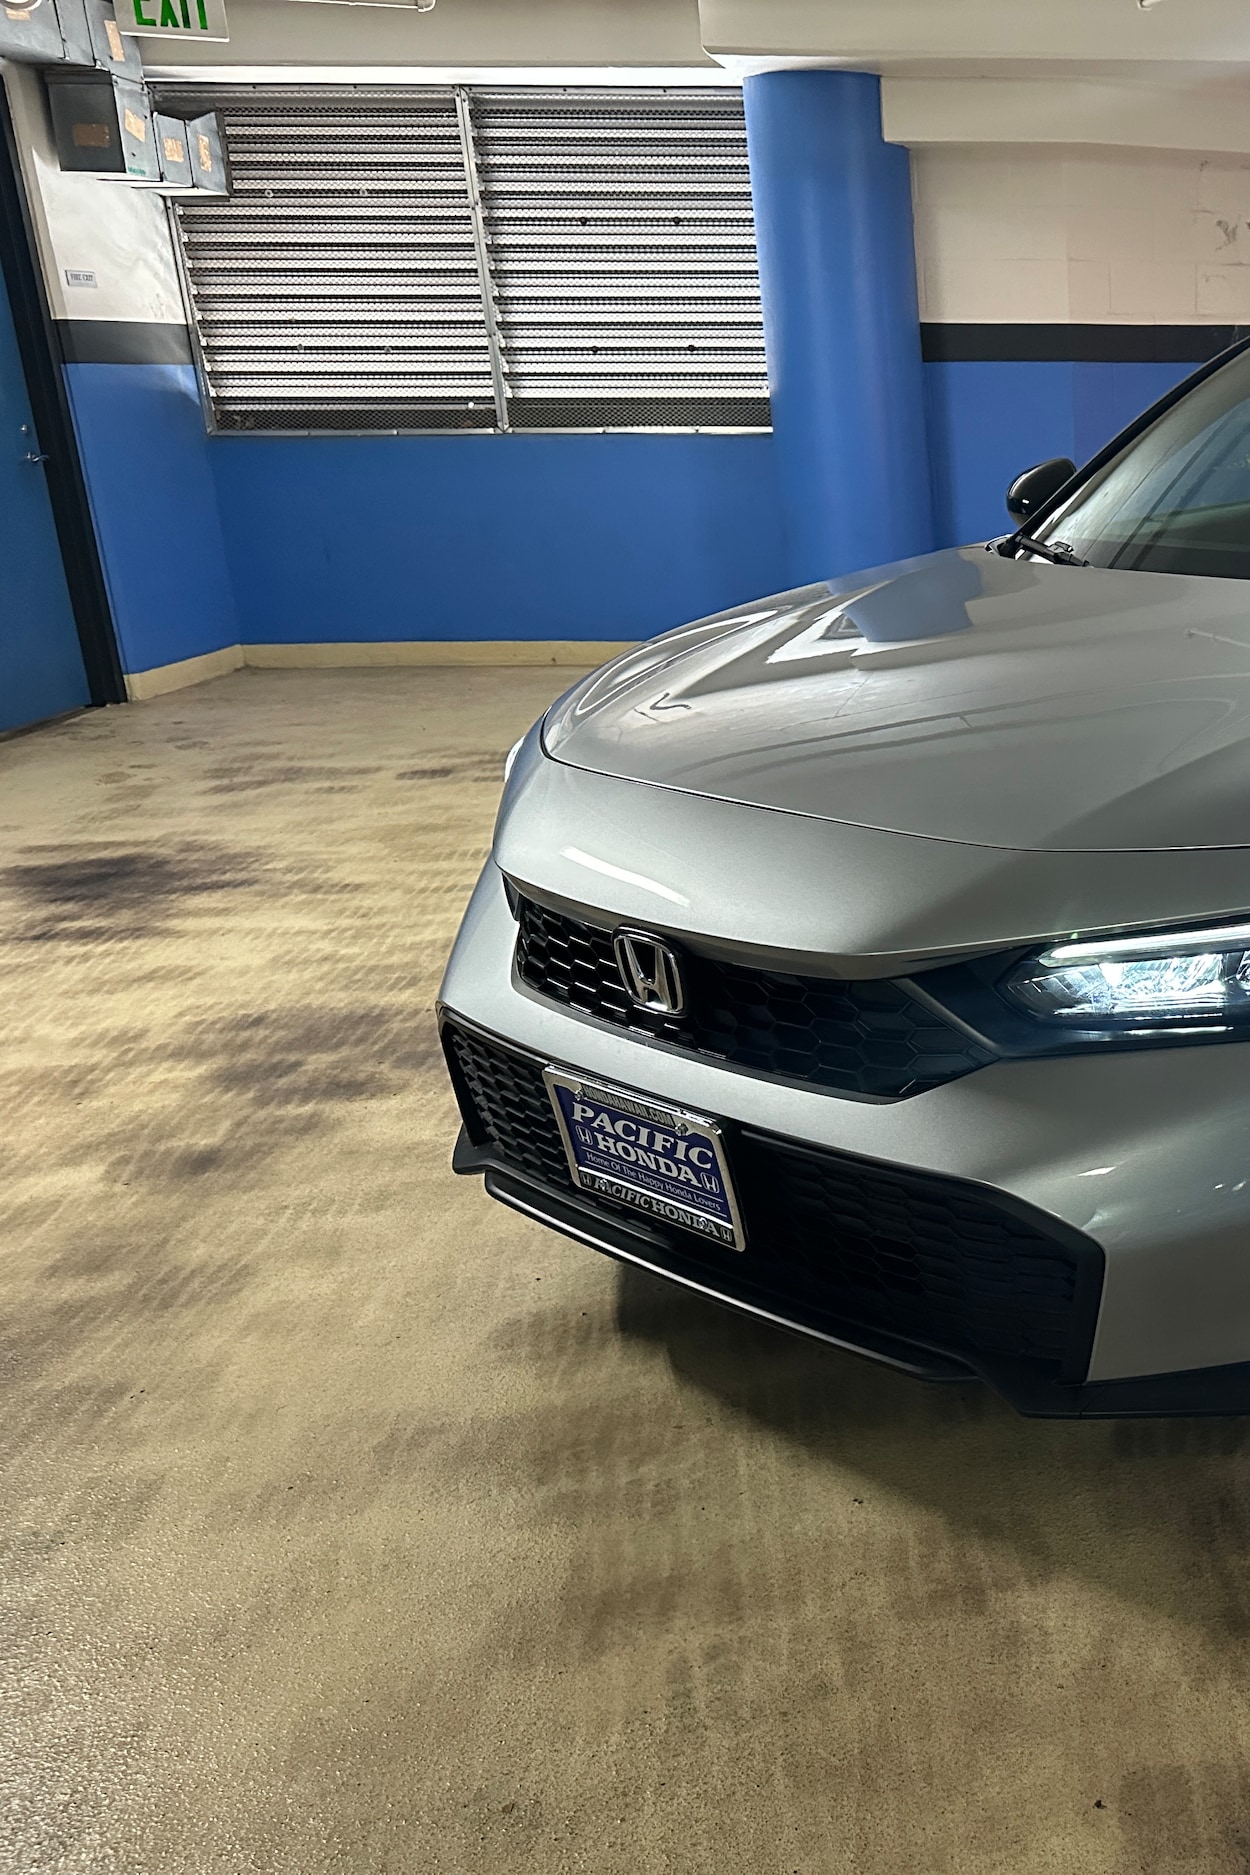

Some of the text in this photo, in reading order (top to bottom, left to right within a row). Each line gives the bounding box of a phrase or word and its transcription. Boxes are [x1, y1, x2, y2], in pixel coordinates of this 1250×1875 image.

[571, 1101, 713, 1169] PACIFIC
[594, 1131, 702, 1188] HONDA
[586, 1151, 721, 1211] Home Of The Happy Honda Lovers
